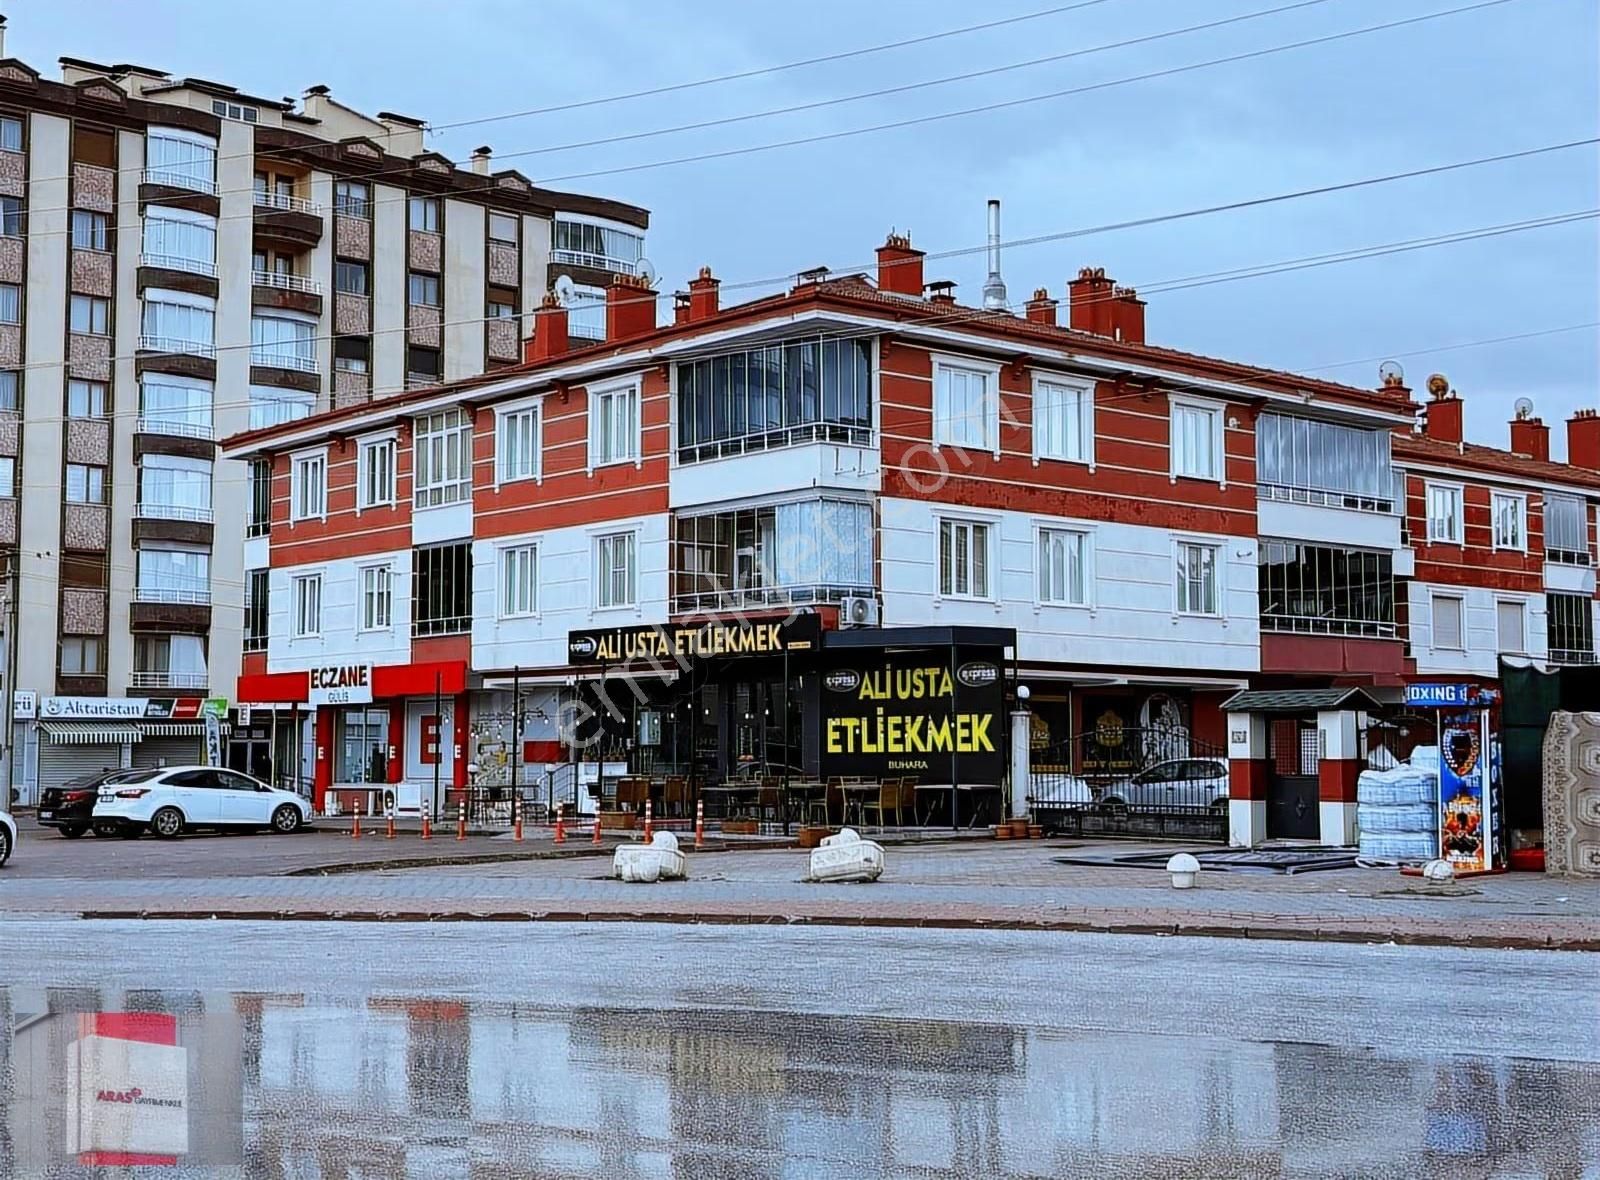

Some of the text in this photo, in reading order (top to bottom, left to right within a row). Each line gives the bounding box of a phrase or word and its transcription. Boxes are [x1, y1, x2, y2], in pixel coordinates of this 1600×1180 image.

[596, 622, 782, 660] ALİ USTA ETLİEKMEK
[311, 665, 368, 688] ECZANE
[859, 664, 953, 699] ALİ USTA
[64, 700, 140, 715] Aktaristan
[827, 707, 996, 753] ETLİEKMEK
[317, 747, 325, 760] E
[389, 745, 396, 759] E
[454, 745, 462, 758] E
[888, 761, 928, 769] BUHARA
